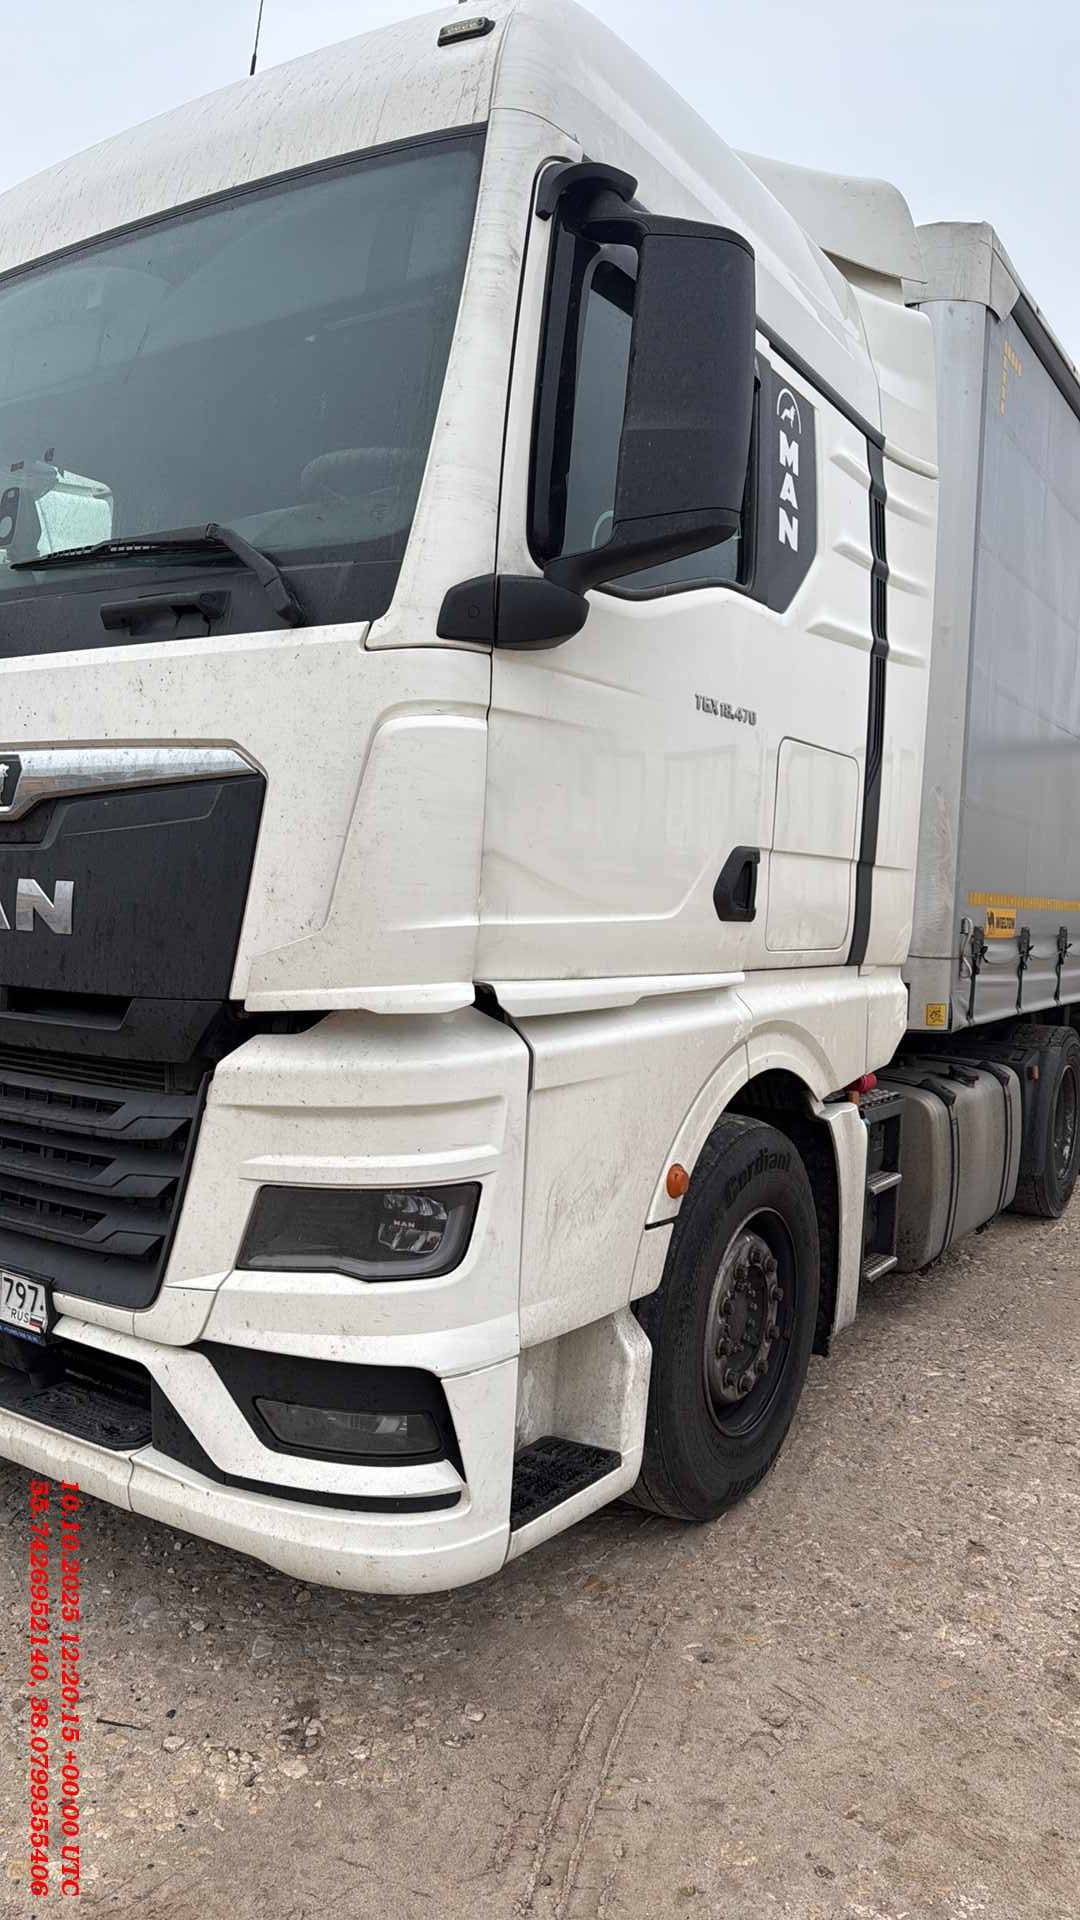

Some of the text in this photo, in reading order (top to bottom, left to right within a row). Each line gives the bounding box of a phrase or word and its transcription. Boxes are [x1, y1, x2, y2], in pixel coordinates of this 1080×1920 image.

[778, 429, 800, 553] MAN
[694, 693, 757, 726] TGX 18.470
[721, 1146, 793, 1209] Cordiant
[393, 1219, 416, 1229] MAN
[3, 1276, 39, 1313] 797
[10, 1307, 30, 1323] RUS
